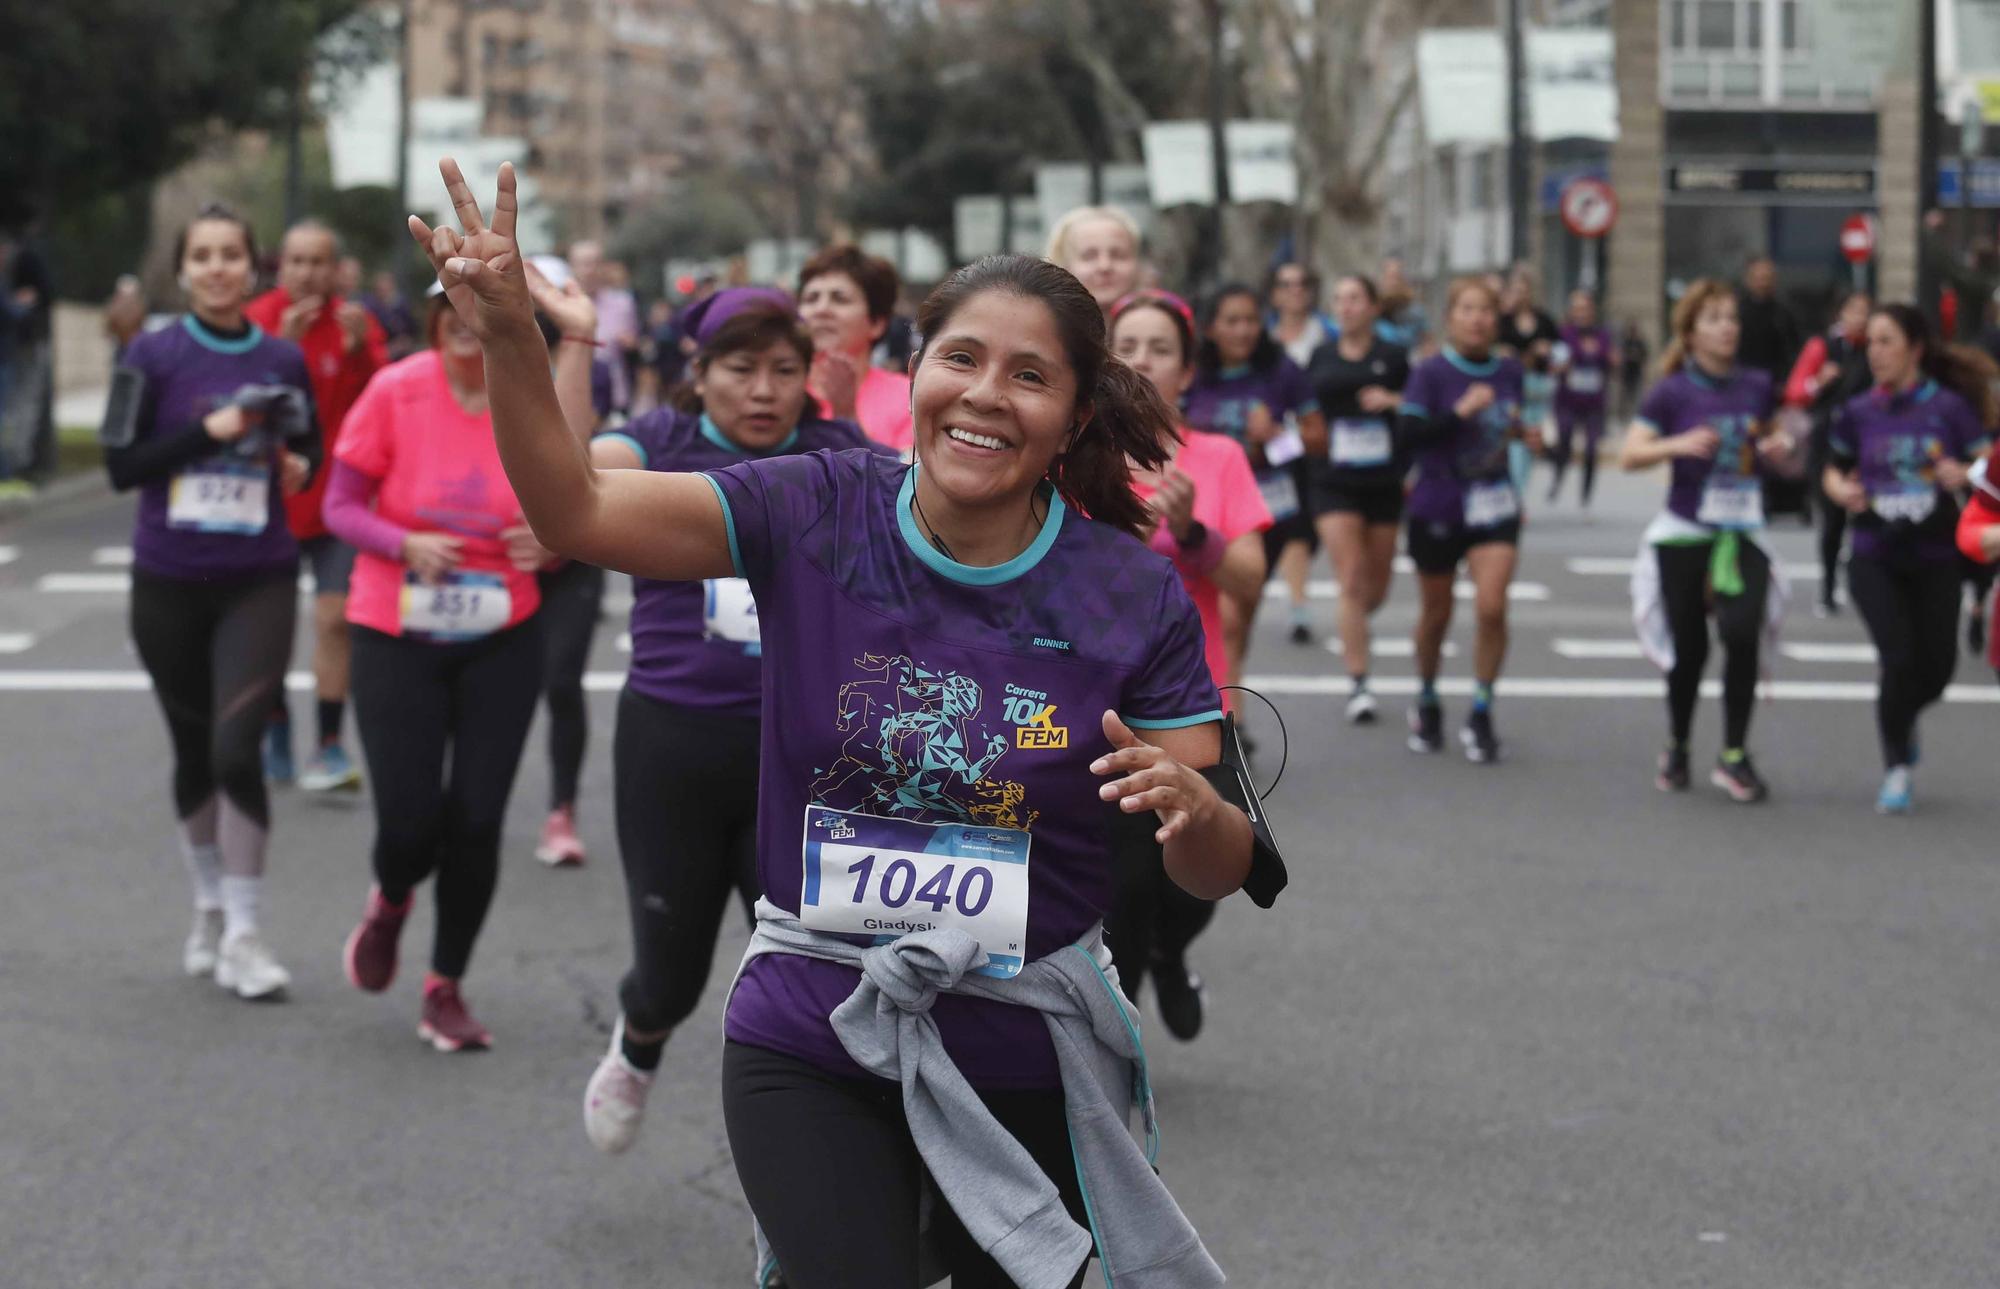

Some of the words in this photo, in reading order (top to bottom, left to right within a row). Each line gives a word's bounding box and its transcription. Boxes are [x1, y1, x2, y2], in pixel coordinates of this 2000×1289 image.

[1033, 638, 1070, 650] RUNNEK
[1005, 683, 1047, 700] Carrera
[1003, 697, 1057, 729] 10K
[1020, 730, 1064, 746] FEM
[832, 829, 854, 839] FEM
[847, 854, 994, 917] 1040
[1008, 943, 1017, 951] M
